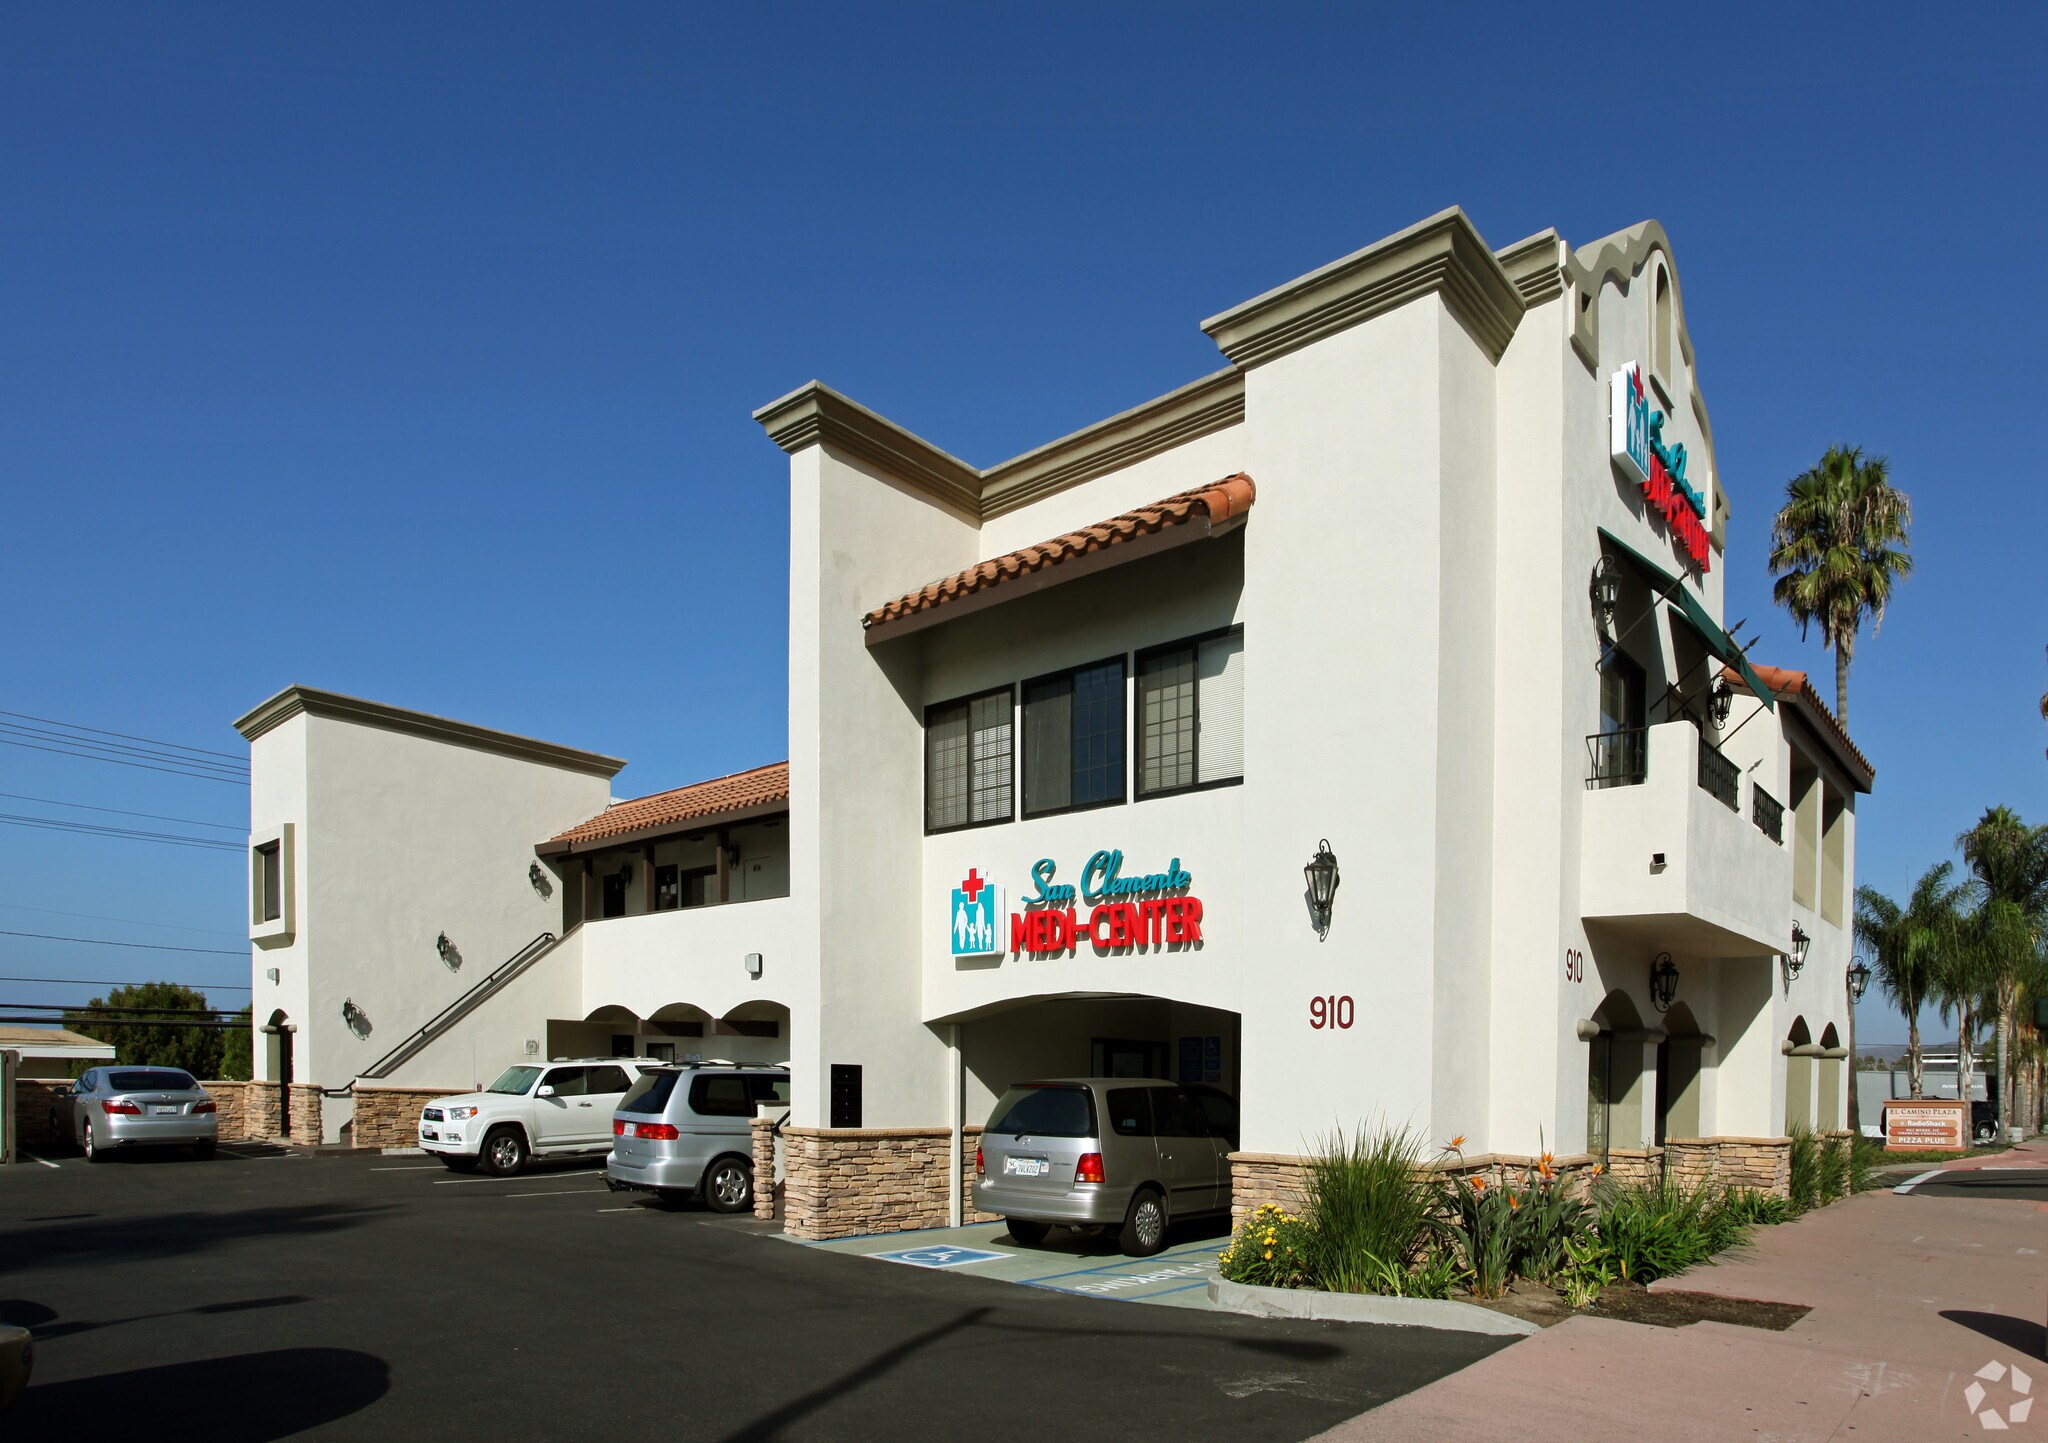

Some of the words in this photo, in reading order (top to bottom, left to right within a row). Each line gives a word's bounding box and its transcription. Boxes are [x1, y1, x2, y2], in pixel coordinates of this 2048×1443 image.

[1021, 858, 1075, 903] San
[1080, 849, 1192, 897] Clemente
[1011, 896, 1203, 953] MEDI-CENTER
[1566, 948, 1583, 984] 910
[1310, 995, 1355, 1030] 910
[1075, 1266, 1206, 1293] PARKING
